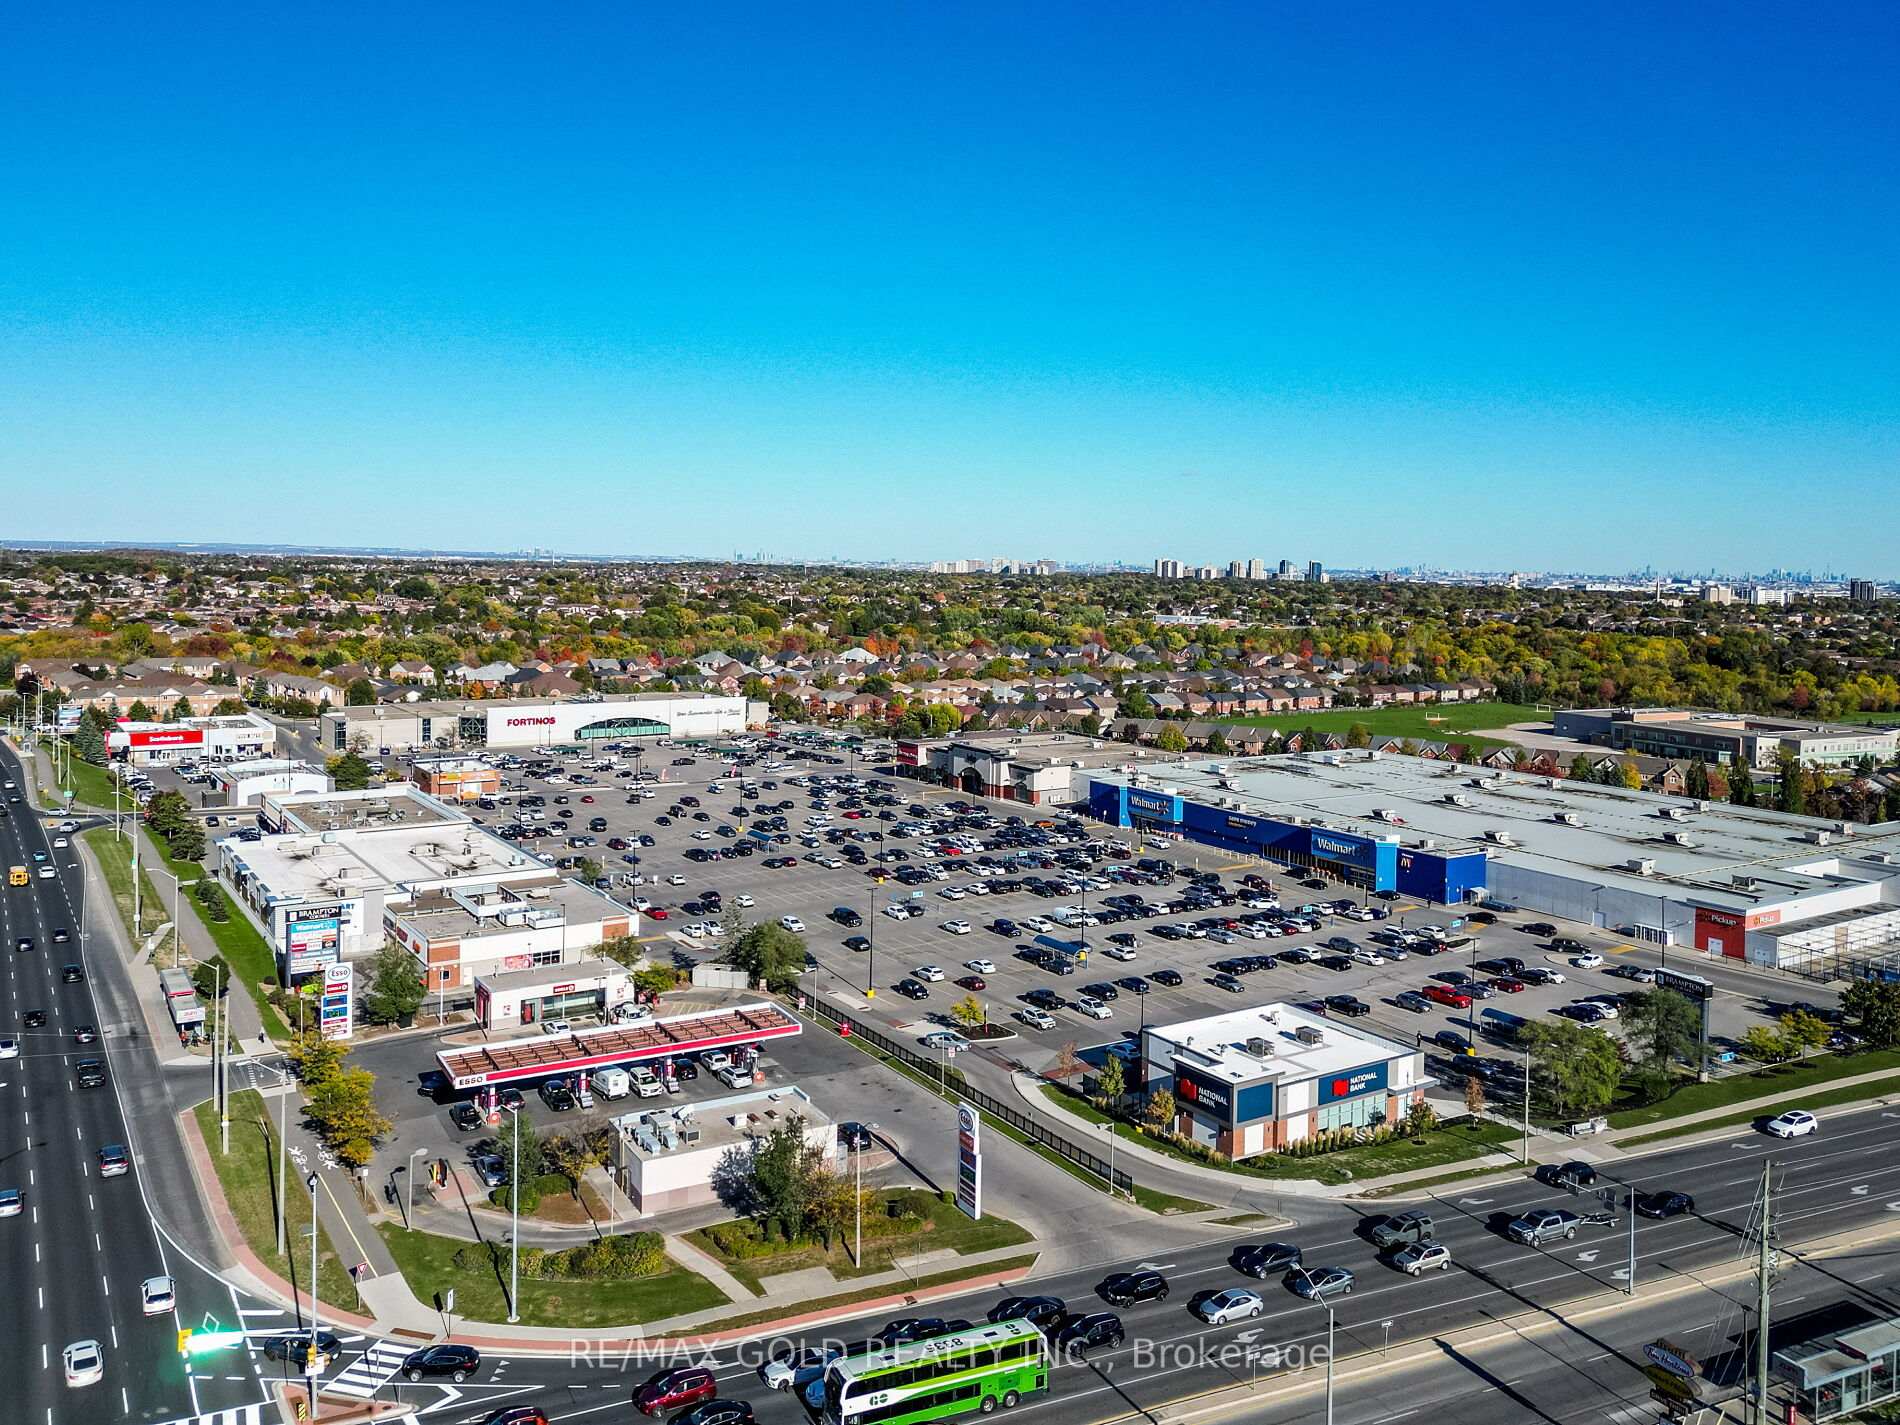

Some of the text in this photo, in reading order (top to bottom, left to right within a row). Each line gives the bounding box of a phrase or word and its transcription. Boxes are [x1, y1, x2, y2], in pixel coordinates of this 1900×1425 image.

[507, 717, 556, 726] FORTINOS
[1131, 795, 1160, 811] Walmart
[1318, 838, 1355, 857] Walmart
[299, 907, 339, 917] BRAMPTON
[1711, 914, 1737, 926] Pickup
[1665, 975, 1703, 993] BRAMPTON
[459, 1076, 483, 1086] ESSO
[1350, 1072, 1377, 1084] NATIONAL
[1350, 1082, 1366, 1092] BANK
[1198, 1087, 1228, 1106] NATIONAL
[1198, 1095, 1216, 1109] BANK
